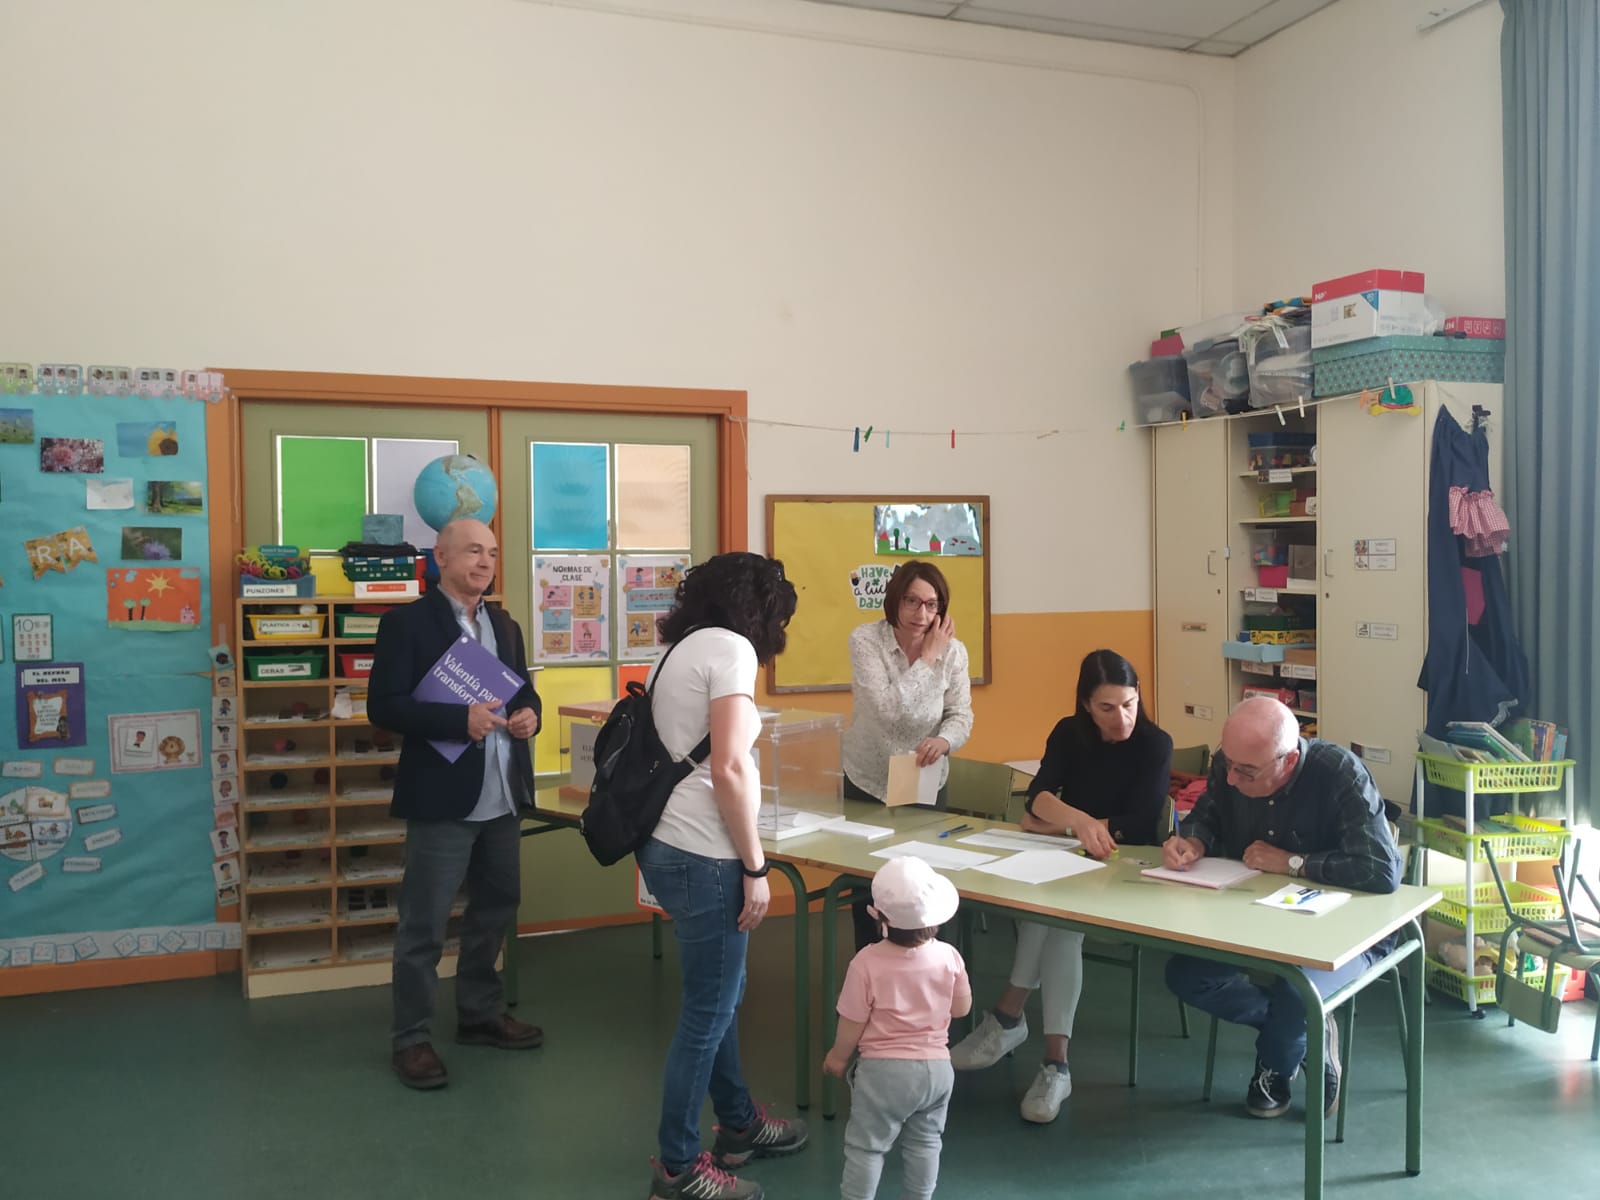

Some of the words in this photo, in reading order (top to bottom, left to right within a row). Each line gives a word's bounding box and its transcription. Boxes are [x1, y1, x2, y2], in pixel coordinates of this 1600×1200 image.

[552, 565, 583, 574] NORMAS
[583, 565, 593, 574] DE
[562, 574, 583, 582] CLASE
[854, 587, 862, 596] a
[15, 618, 34, 632] 10
[443, 653, 481, 690] Valentía
[477, 687, 498, 703] par
[433, 666, 481, 705] transform
